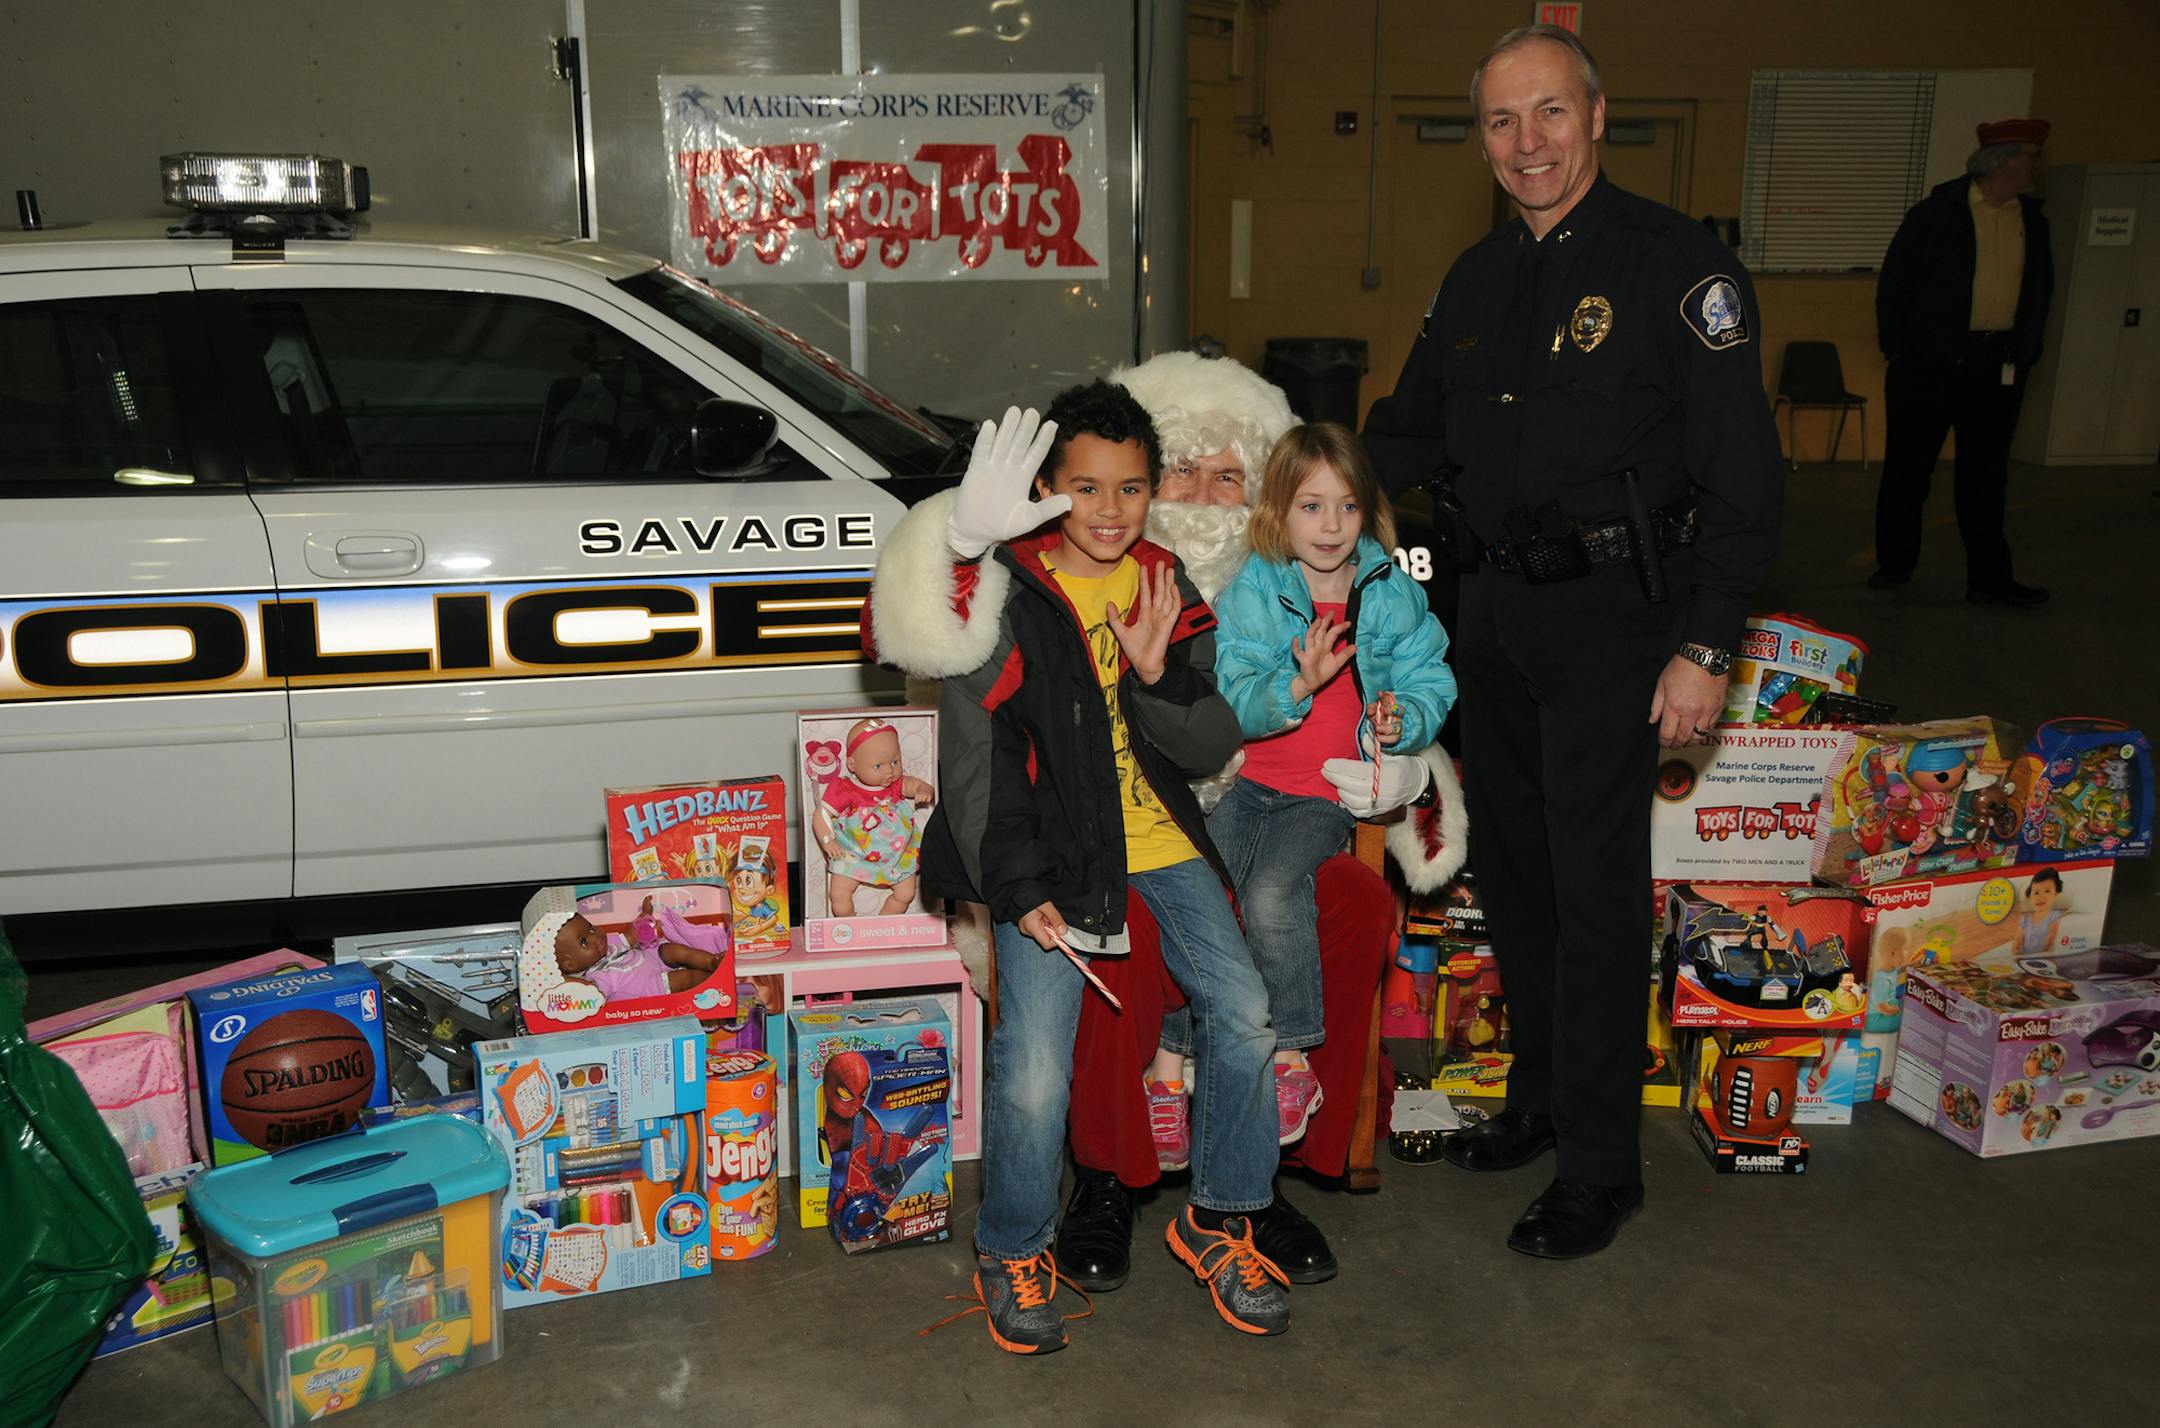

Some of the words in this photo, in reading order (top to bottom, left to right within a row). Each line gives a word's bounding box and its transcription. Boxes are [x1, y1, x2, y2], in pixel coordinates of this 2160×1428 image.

[722, 94, 834, 118] MARINE
[838, 93, 928, 118] CORPS
[936, 92, 1050, 117] RESERVE
[696, 160, 803, 223] TOYS
[832, 173, 920, 228] FOR
[949, 181, 1062, 237] TOTS
[578, 513, 876, 556] SAVAGE
[0, 580, 868, 691] OLICE
[1790, 640, 1828, 665] first
[1801, 737, 1838, 749] TOYS
[1716, 762, 1749, 771] Marine
[1751, 762, 1777, 772] Corps
[1779, 763, 1815, 772] Reserve
[1705, 775, 1737, 784] Savage
[1739, 775, 1766, 784] Police
[1768, 775, 1823, 785] Department
[624, 789, 768, 846] HEDBANZ
[693, 818, 706, 827] The
[707, 816, 730, 826] QUICK
[730, 815, 761, 824] Question
[761, 813, 782, 821] Game
[1700, 812, 1738, 831] TOYS
[1744, 812, 1776, 828] FOR
[1871, 889, 1929, 905] Fisher-Price
[860, 927, 895, 938] sweet
[898, 925, 908, 936] &
[911, 925, 936, 935] new
[231, 971, 335, 998] SPALDING
[546, 998, 598, 1013] MOMMY
[548, 993, 572, 1003] little
[605, 1011, 629, 1020] baby
[642, 1008, 663, 1016] new
[1732, 1039, 1774, 1056] NERF
[243, 1049, 366, 1098] SPALDING
[889, 1090, 943, 1110] SOUNDS!
[1735, 1155, 1785, 1166] CLASSIC
[899, 1191, 931, 1209] TRY
[904, 1202, 930, 1218] ME!
[735, 1221, 757, 1237] FUN!
[903, 1217, 946, 1237] GLOVE
[905, 1214, 930, 1228] HERO
[387, 1223, 439, 1244] Sketchbook
